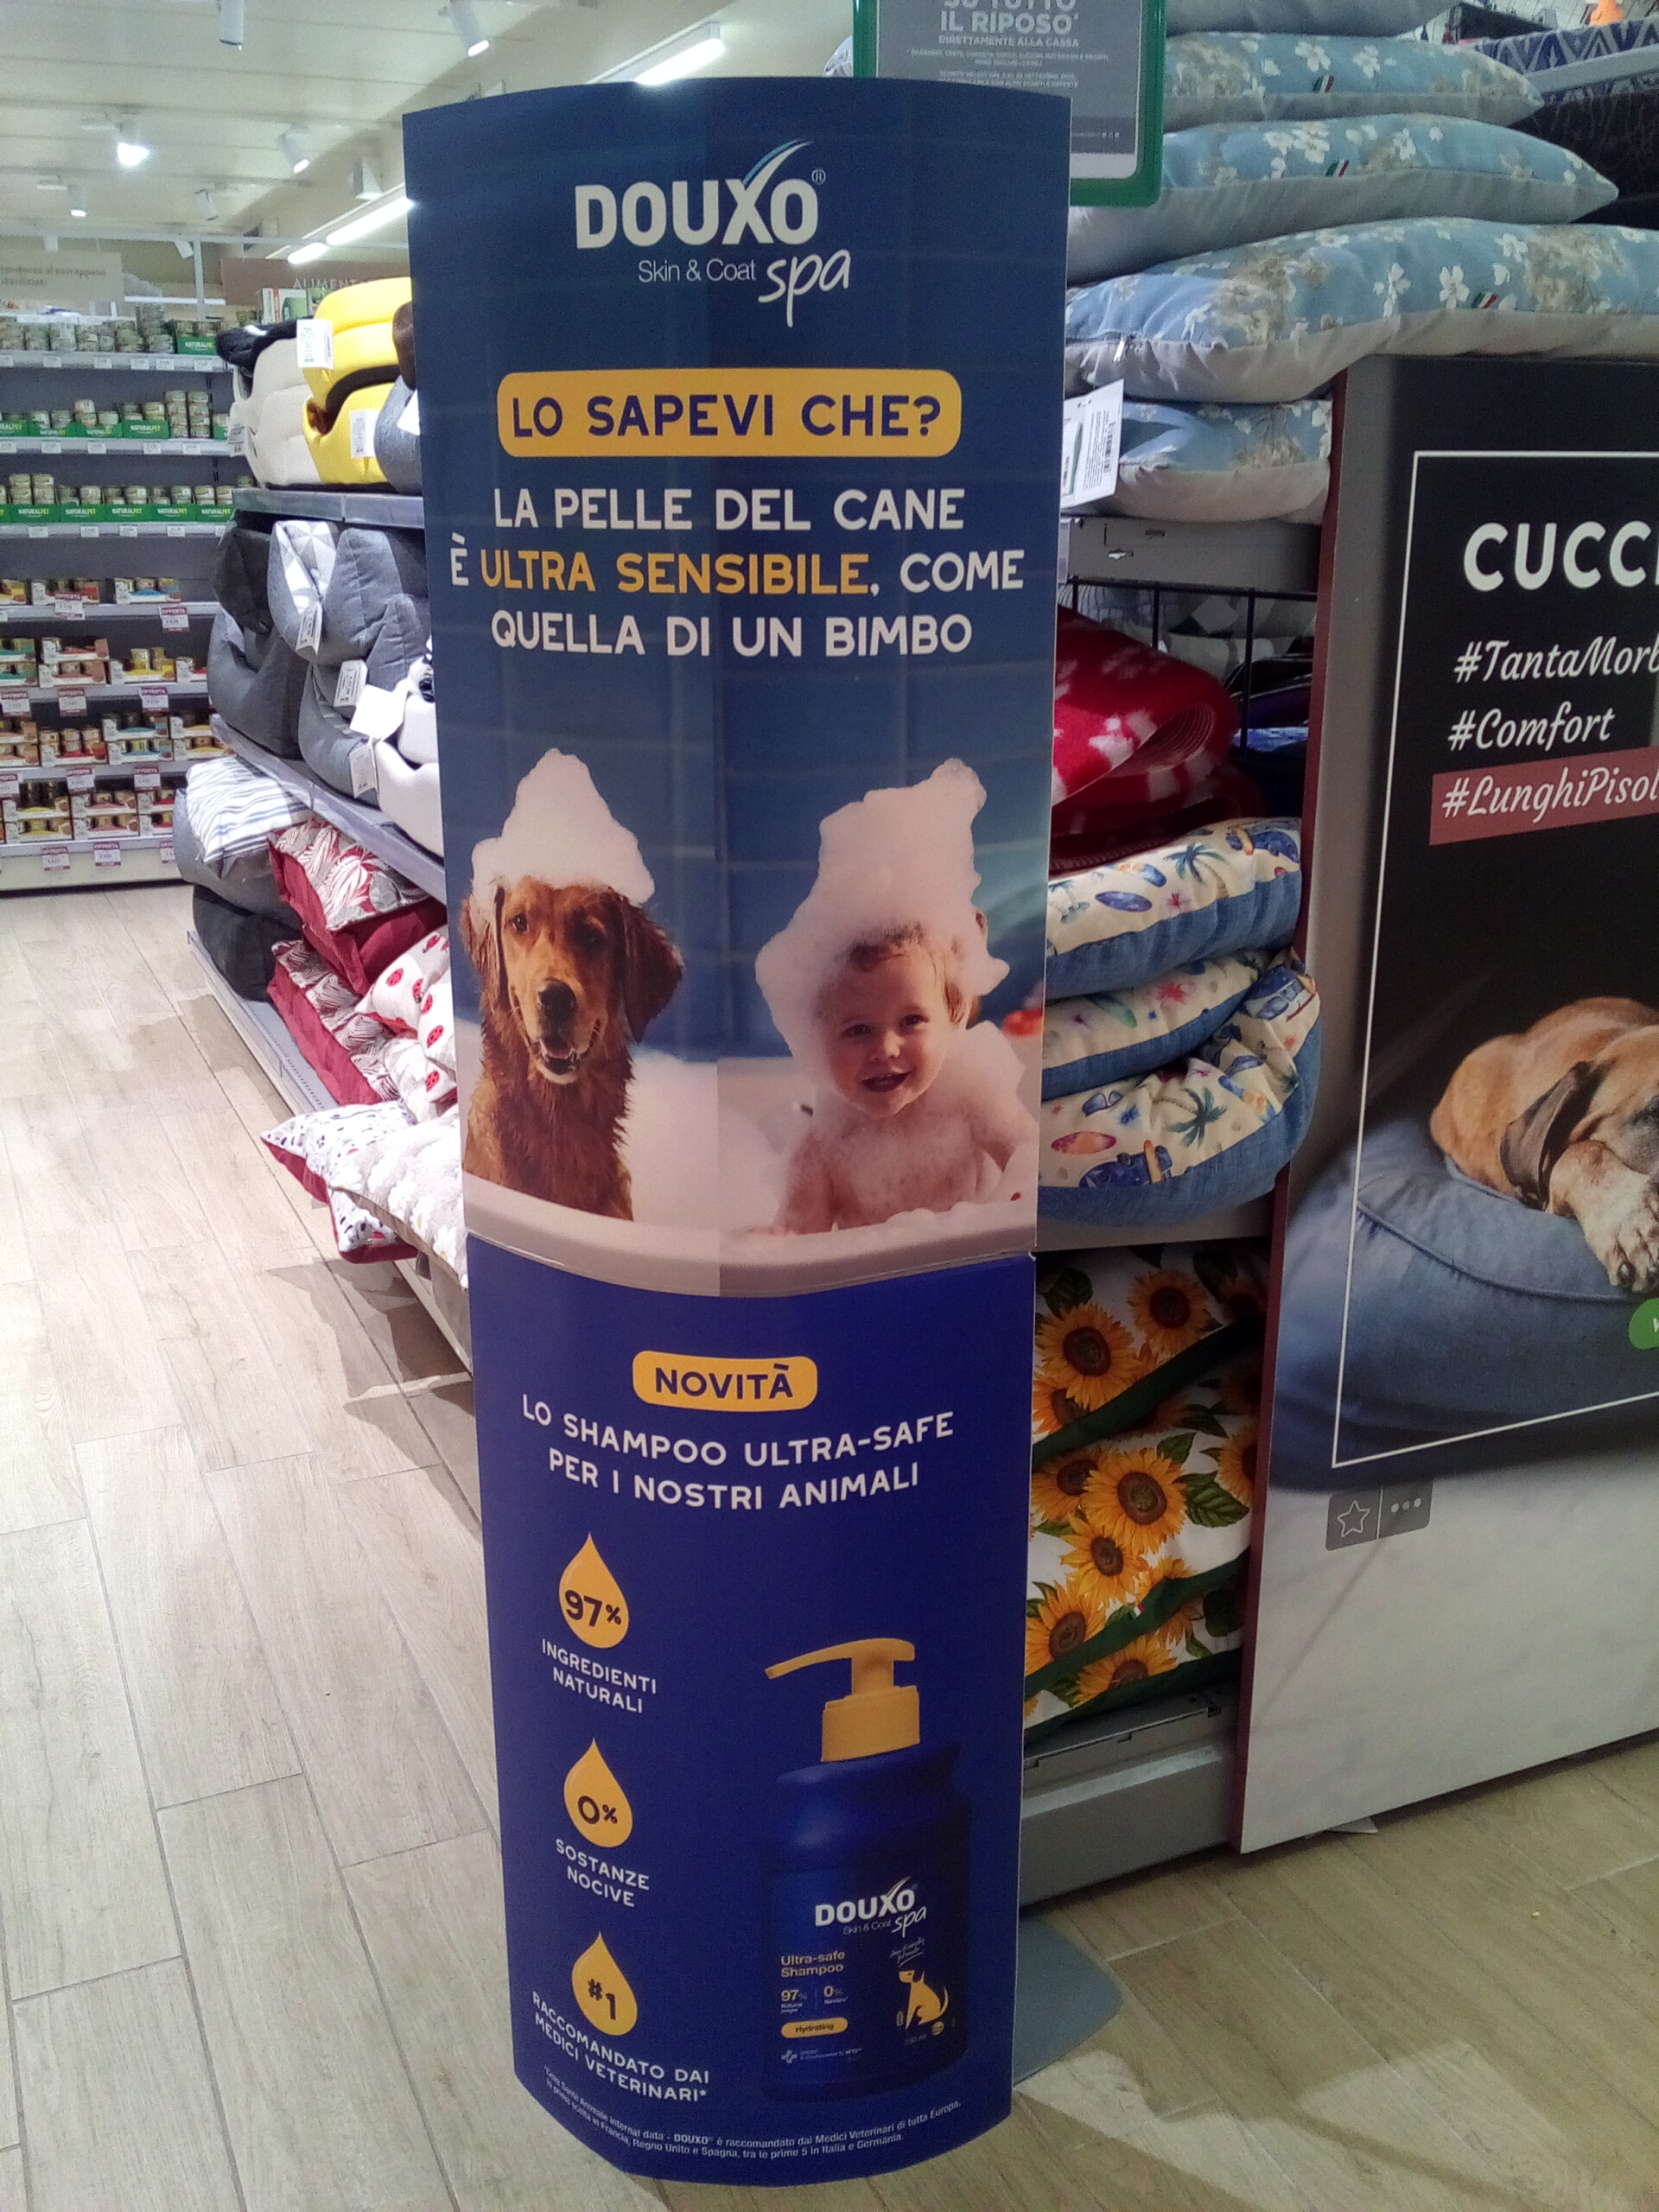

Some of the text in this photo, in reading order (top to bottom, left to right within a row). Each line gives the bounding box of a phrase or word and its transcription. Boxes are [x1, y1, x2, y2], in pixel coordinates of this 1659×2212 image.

[938, 35, 1079, 48] DIRETTAMENTE ALLA CASSA
[940, 10, 963, 32] IL
[639, 249, 851, 328] Skin & Coat spa
[512, 394, 943, 438] LO SAPEVI CHE?
[493, 488, 965, 531] LA PELLE DEL CANE
[449, 531, 1026, 598] È ULTRA SENSIBILE, COME
[1463, 520, 1659, 592] CUCC
[491, 609, 972, 657] QUELLA DI UN BIMBO
[1448, 701, 1616, 752] #Comfort
[655, 1363, 794, 1401] NOVITÀ
[522, 1393, 955, 1467] LO SHAMPOO ULTRA-SAFE
[550, 1447, 919, 1510] PER I NOSTRI ANIMALI
[564, 1589, 622, 1628] 97%
[542, 1638, 657, 1694] INGREDIENTI
[553, 1666, 643, 1713] NATURALI
[577, 1795, 618, 1825] 0%
[556, 1838, 650, 1891] SOSTANZE
[567, 1865, 634, 1907] NOCIVE
[842, 1923, 861, 1935] Skin
[871, 1919, 892, 1929] Coat
[891, 1906, 927, 1938] spa
[780, 1950, 846, 1966] Ultra-safe
[780, 1963, 844, 1978] Shampoo
[588, 1979, 616, 2021] #1
[781, 1989, 808, 2002] 97%
[532, 1991, 709, 2084] RACCOMANDATO DAI
[535, 2012, 579, 2061] MEDICI
[795, 2022, 835, 2034] Hydrating
[601, 2122, 631, 2147] Francia,
[632, 2139, 663, 2153] Regno
[665, 2143, 690, 2154] Unito
[702, 2146, 741, 2160] Spagna,
[743, 2149, 757, 2158] tra
[759, 2149, 768, 2158] le
[771, 2149, 798, 2160] prime
[801, 2146, 808, 2157] 5
[810, 2145, 820, 2155] in
[822, 2142, 846, 2154] Italia
[856, 2134, 903, 2150] Germania.
[609, 2116, 640, 2137] internal
[643, 2130, 664, 2141] data
[716, 2136, 723, 2146] è
[725, 2139, 795, 2148] raccomandato
[798, 2135, 812, 2145] dai
[816, 2132, 848, 2144] Medici
[849, 2123, 894, 2139] Veterinari
[897, 2120, 906, 2130] di
[907, 2114, 928, 2127] tutta
